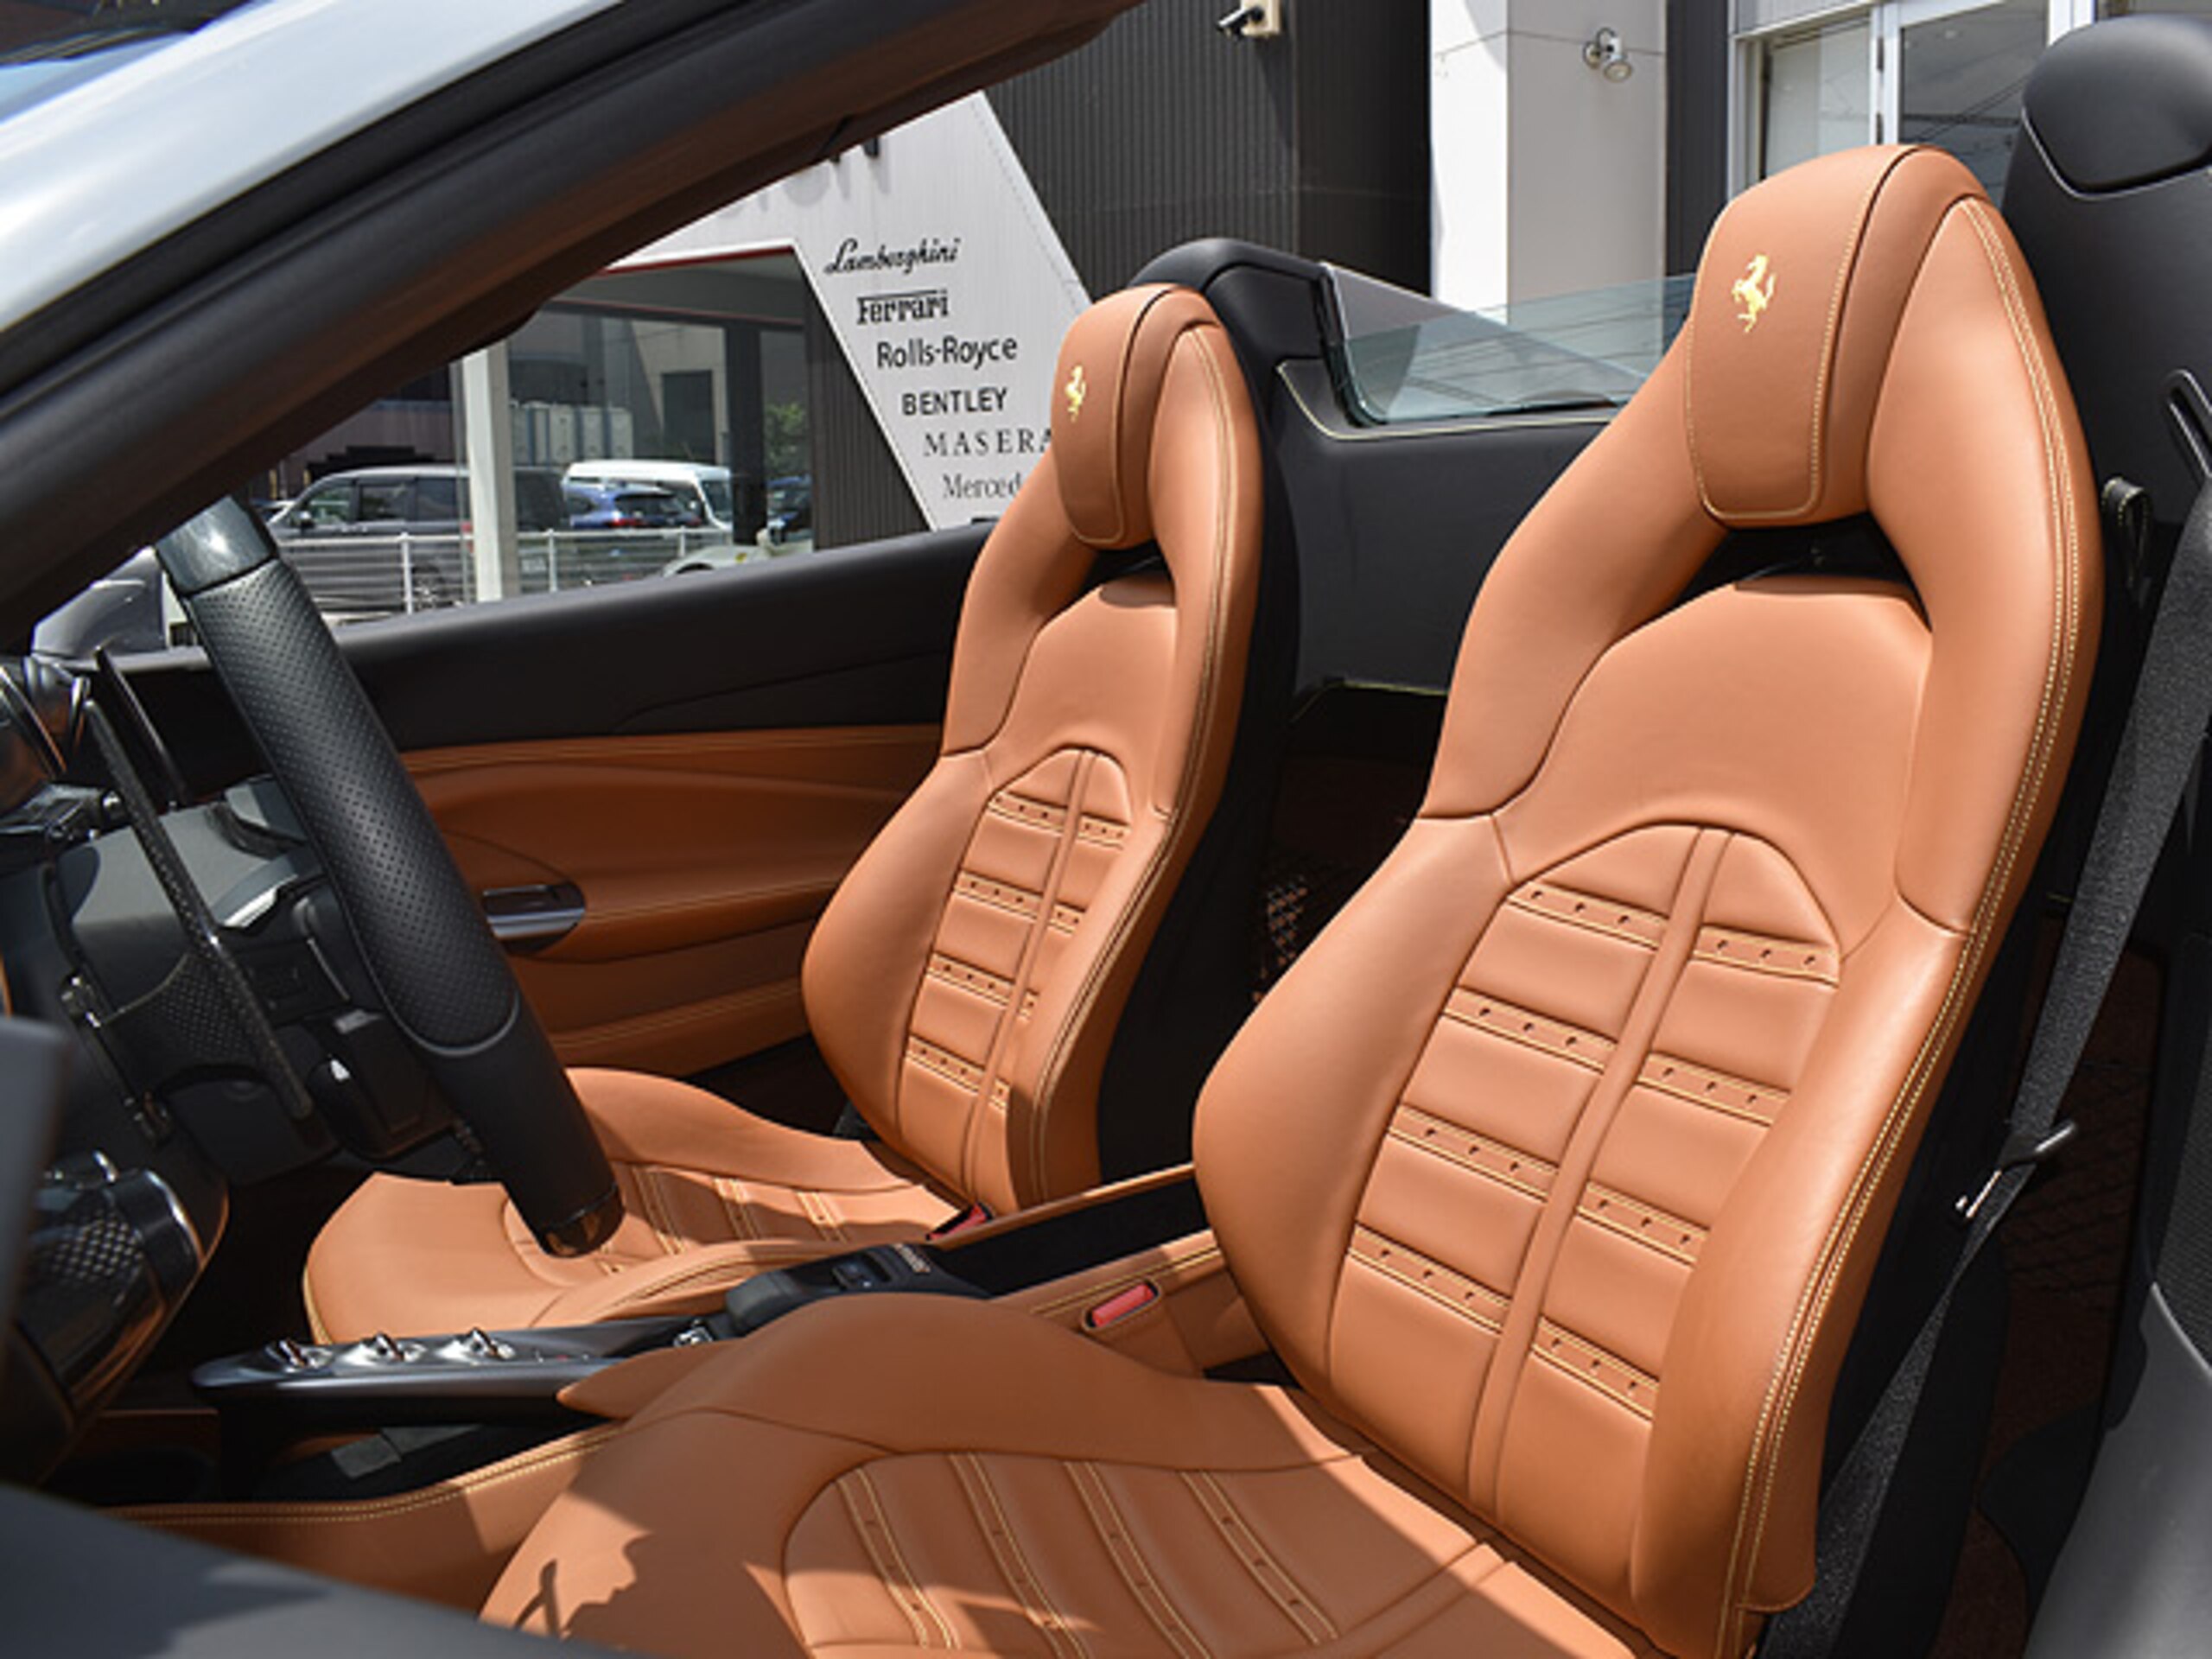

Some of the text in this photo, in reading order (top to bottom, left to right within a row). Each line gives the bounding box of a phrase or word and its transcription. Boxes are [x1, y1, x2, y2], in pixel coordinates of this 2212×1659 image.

[823, 238, 961, 275] Lamborghini
[856, 289, 949, 325] Ferrari
[877, 335, 1018, 370] Rolls-Royce
[901, 386, 1007, 416] BENTLEY
